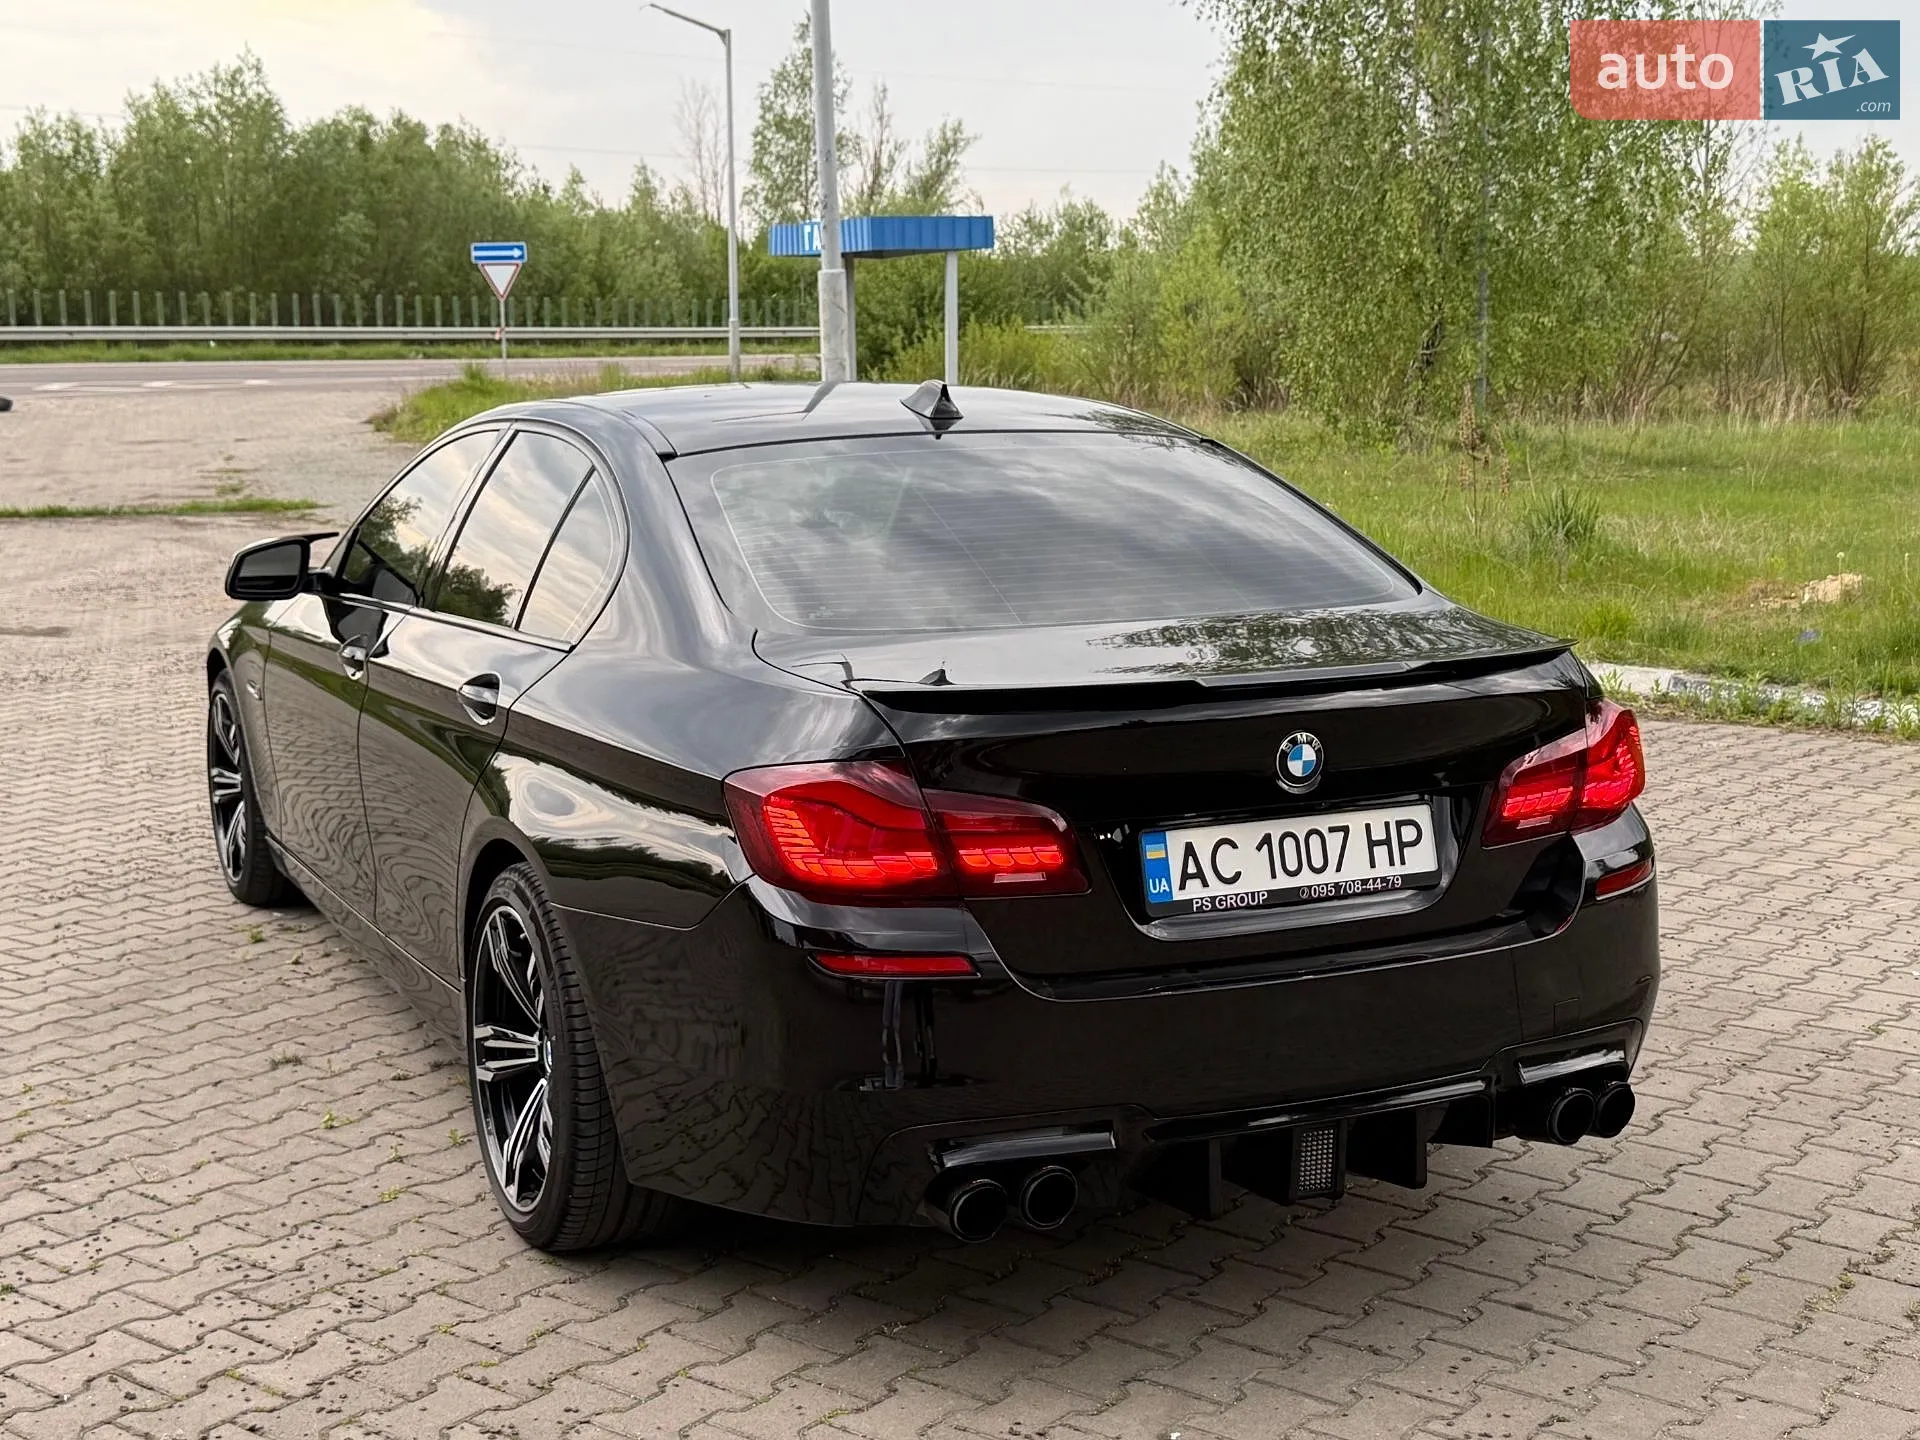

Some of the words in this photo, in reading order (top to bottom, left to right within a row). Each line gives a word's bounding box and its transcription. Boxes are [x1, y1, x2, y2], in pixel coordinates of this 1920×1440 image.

[1178, 837, 1243, 891] AC
[1255, 825, 1350, 879] 1007
[1365, 818, 1423, 869] HP
[1149, 877, 1170, 894] UA
[1311, 884, 1335, 898] 095
[1339, 875, 1402, 895] 708-44-79
[1192, 898, 1213, 912] PS
[1215, 891, 1268, 910] GROUP
